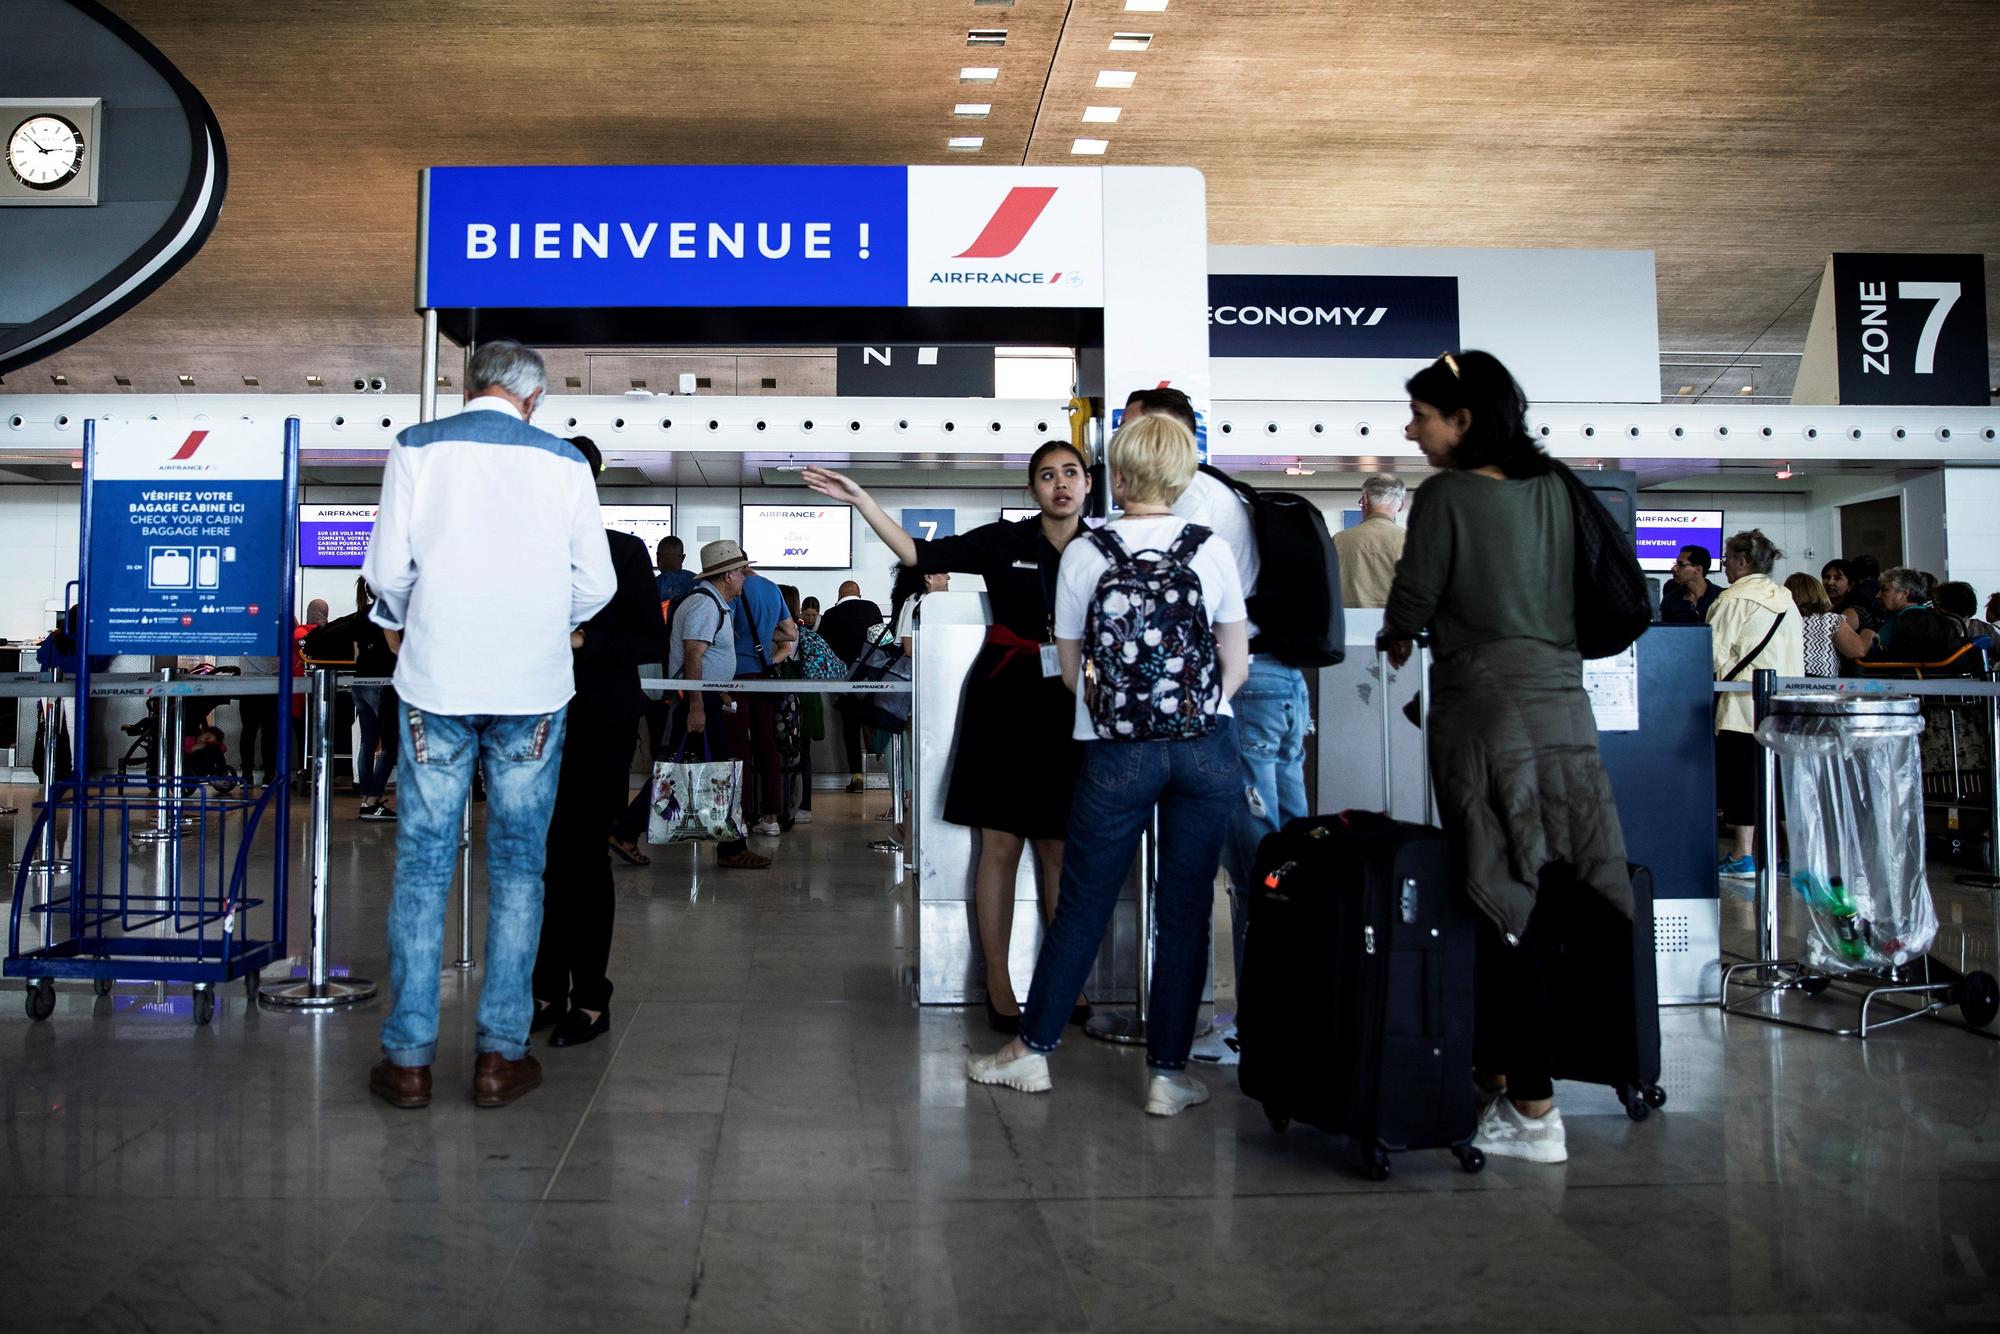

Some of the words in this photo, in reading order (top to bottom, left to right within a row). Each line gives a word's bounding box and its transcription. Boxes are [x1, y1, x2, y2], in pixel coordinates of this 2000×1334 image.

[466, 222, 832, 260] BIENVENUE
[858, 222, 870, 260] !
[929, 272, 1044, 284] AIRFRANCE
[1859, 281, 1890, 375] ZONE
[1898, 281, 1962, 374] 7
[142, 490, 192, 500] VÉRIFIEZ
[195, 492, 233, 500] VOTRE
[129, 503, 178, 512] BAGAGE
[181, 503, 226, 512] CABINE
[228, 503, 245, 512] ICI
[130, 515, 168, 524] CHECK
[172, 515, 203, 524] YOUR
[206, 515, 243, 524] CABIN
[142, 526, 198, 536] BAGGAGE
[202, 526, 230, 536] HERE
[919, 522, 937, 542] 7
